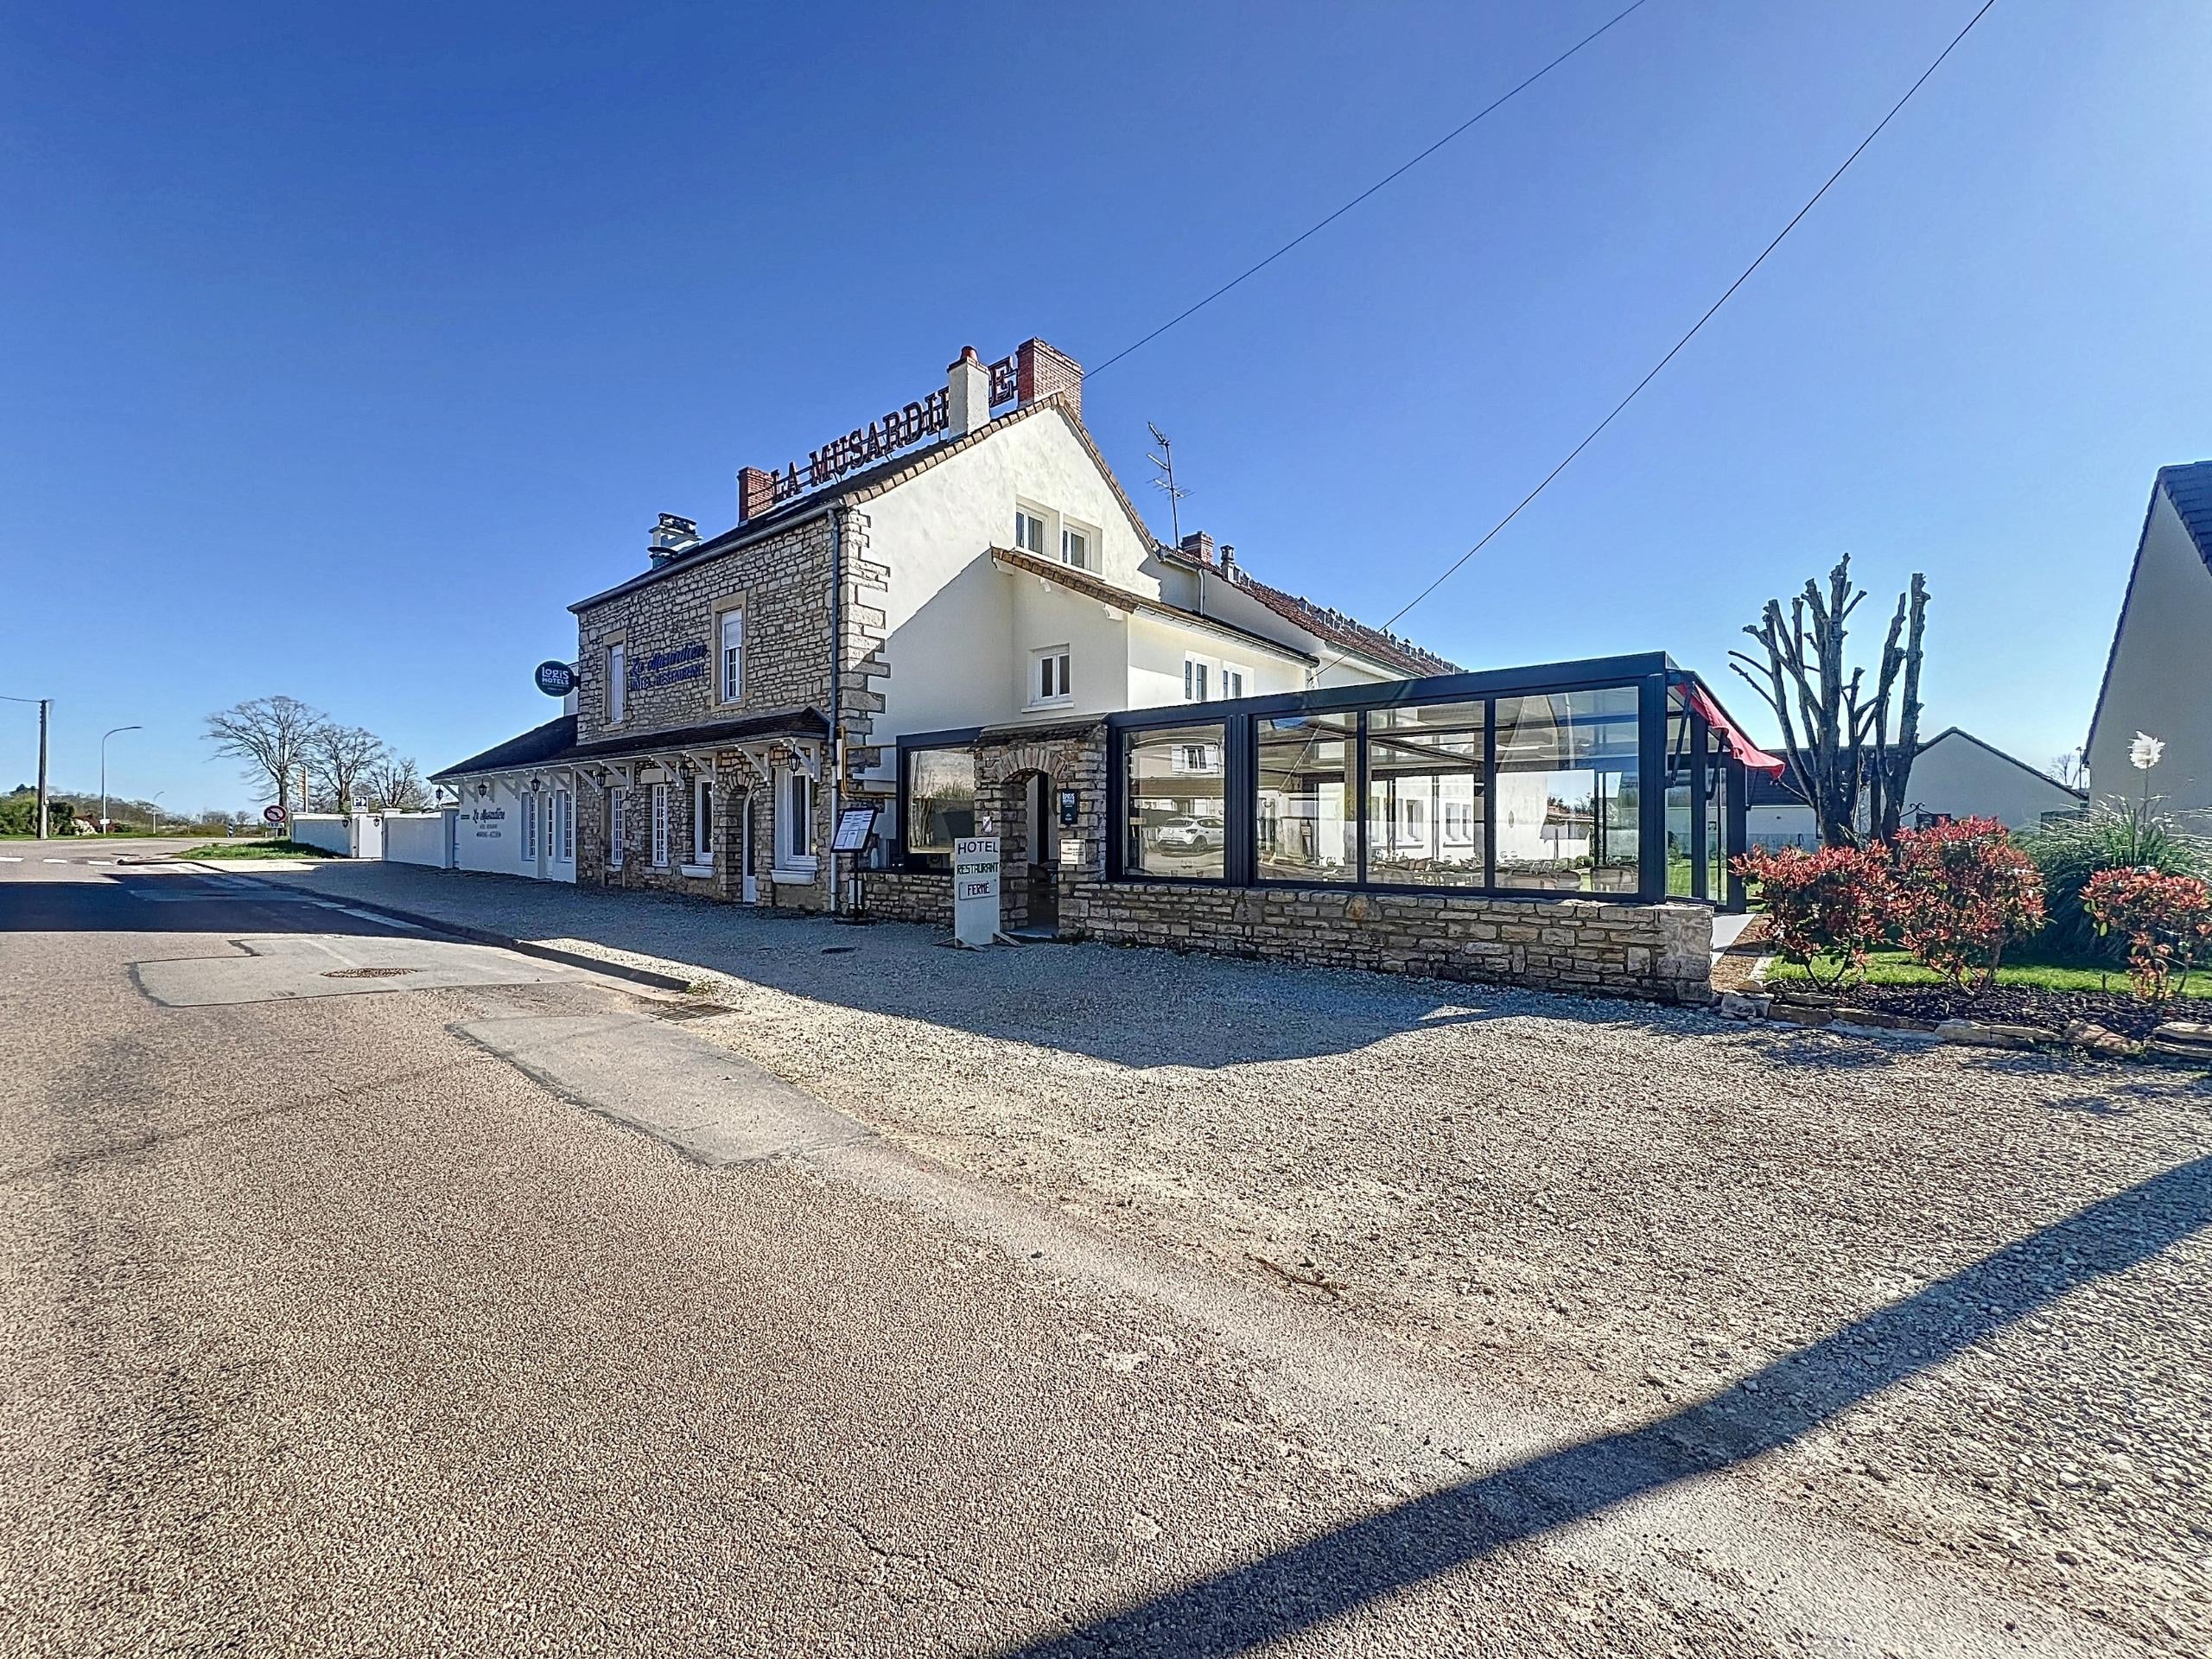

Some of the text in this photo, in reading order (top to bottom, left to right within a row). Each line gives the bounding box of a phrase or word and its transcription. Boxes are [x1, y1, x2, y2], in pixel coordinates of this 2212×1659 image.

[771, 461, 803, 503] LA
[957, 841, 999, 855] HOTEL
[957, 861, 999, 875] RESTAURANT
